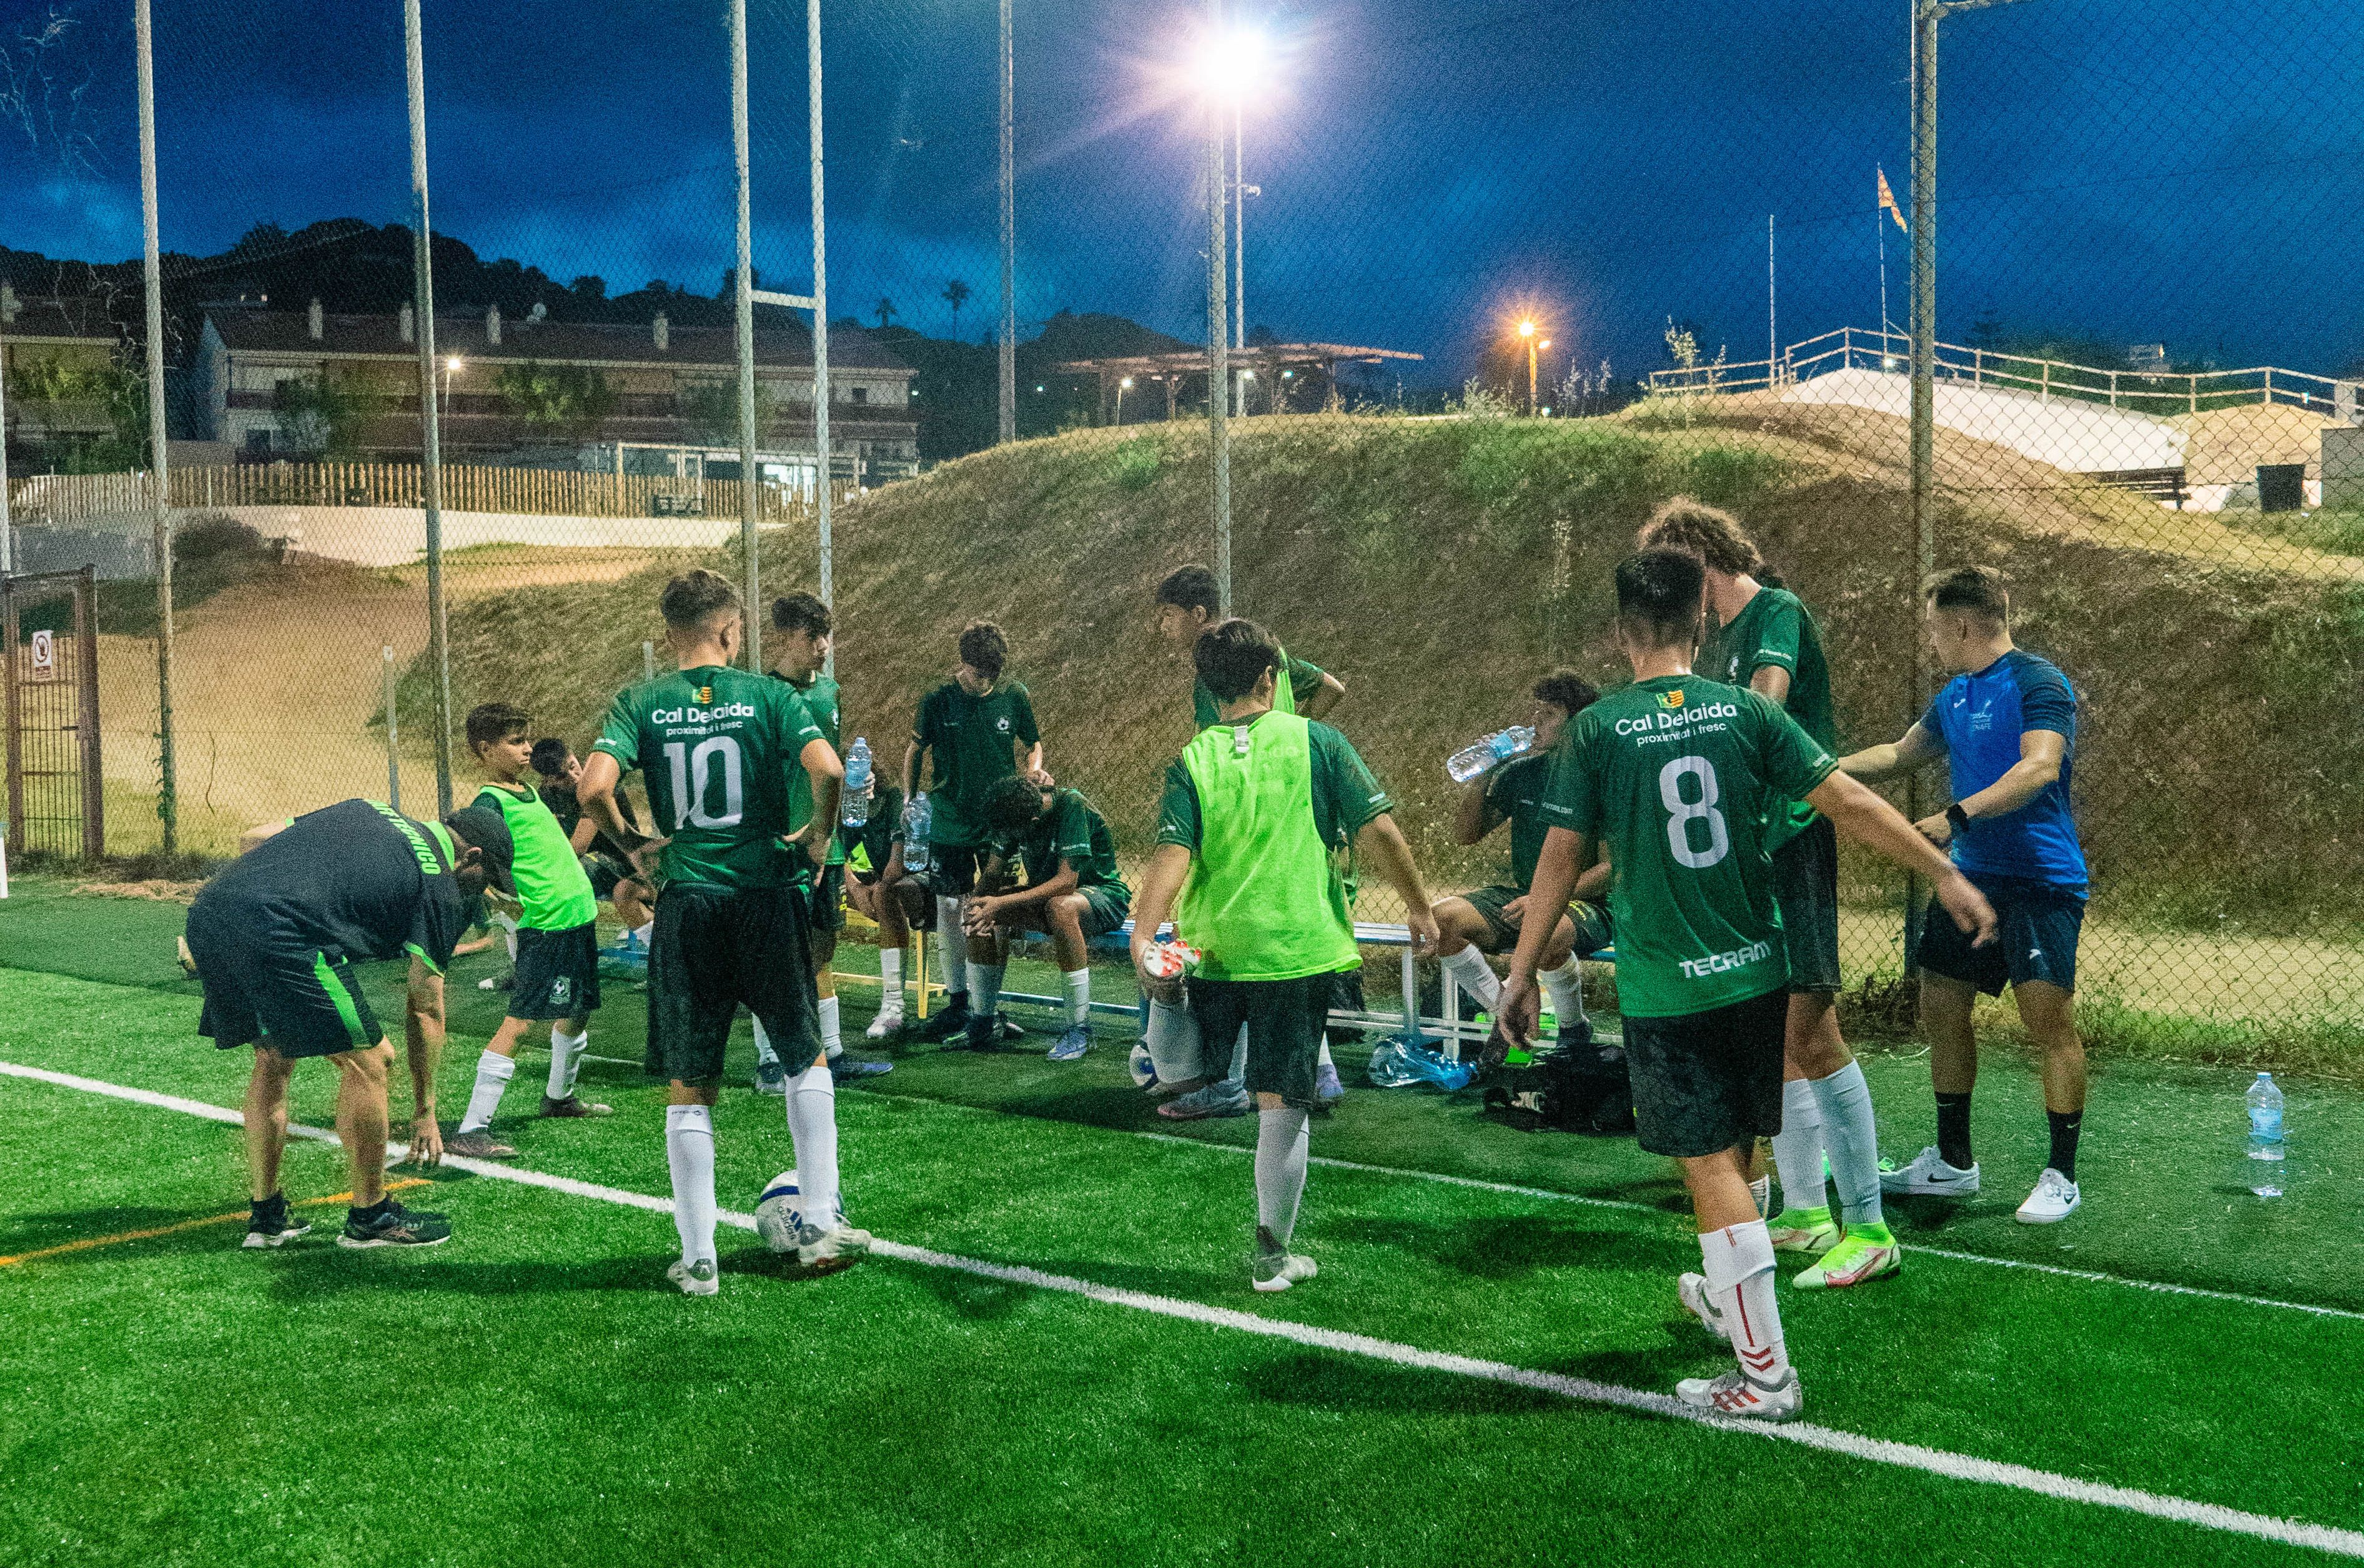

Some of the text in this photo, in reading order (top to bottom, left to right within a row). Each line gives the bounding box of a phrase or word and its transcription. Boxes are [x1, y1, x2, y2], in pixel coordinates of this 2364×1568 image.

[651, 702, 754, 724] Cal Delaida
[666, 724, 714, 737] proximitat
[720, 721, 743, 732] fresc
[1615, 702, 1737, 736] Cal Delaida
[1636, 722, 1727, 747] proximitat i fresc
[663, 736, 743, 829] 10
[1659, 756, 1729, 869] 8
[1678, 940, 1772, 979] TECRAM
